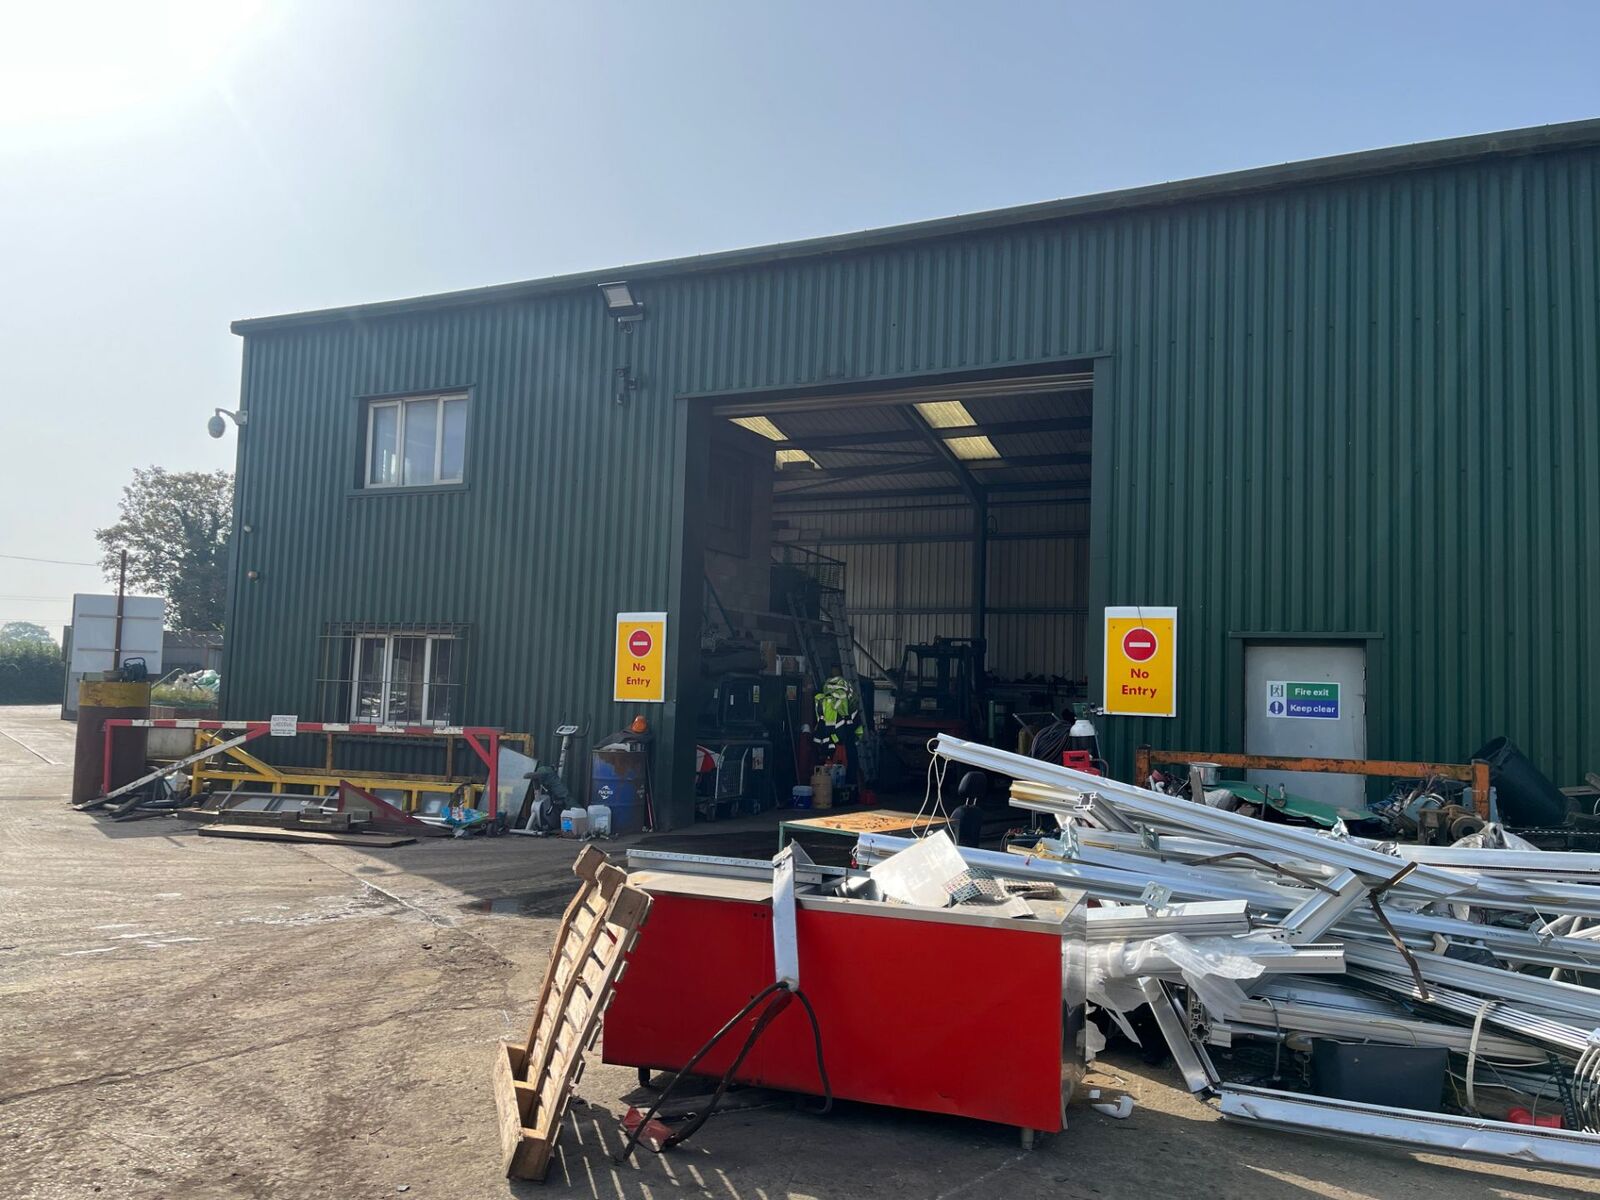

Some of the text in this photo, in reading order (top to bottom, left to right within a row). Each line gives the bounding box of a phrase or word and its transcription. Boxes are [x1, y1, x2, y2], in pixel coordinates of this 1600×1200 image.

[632, 663, 646, 671] No
[1130, 668, 1149, 679] No
[626, 676, 651, 687] Entry
[1121, 684, 1157, 699] Entry
[1294, 687, 1329, 697] Fire exit
[1290, 704, 1336, 714] Keep clear
